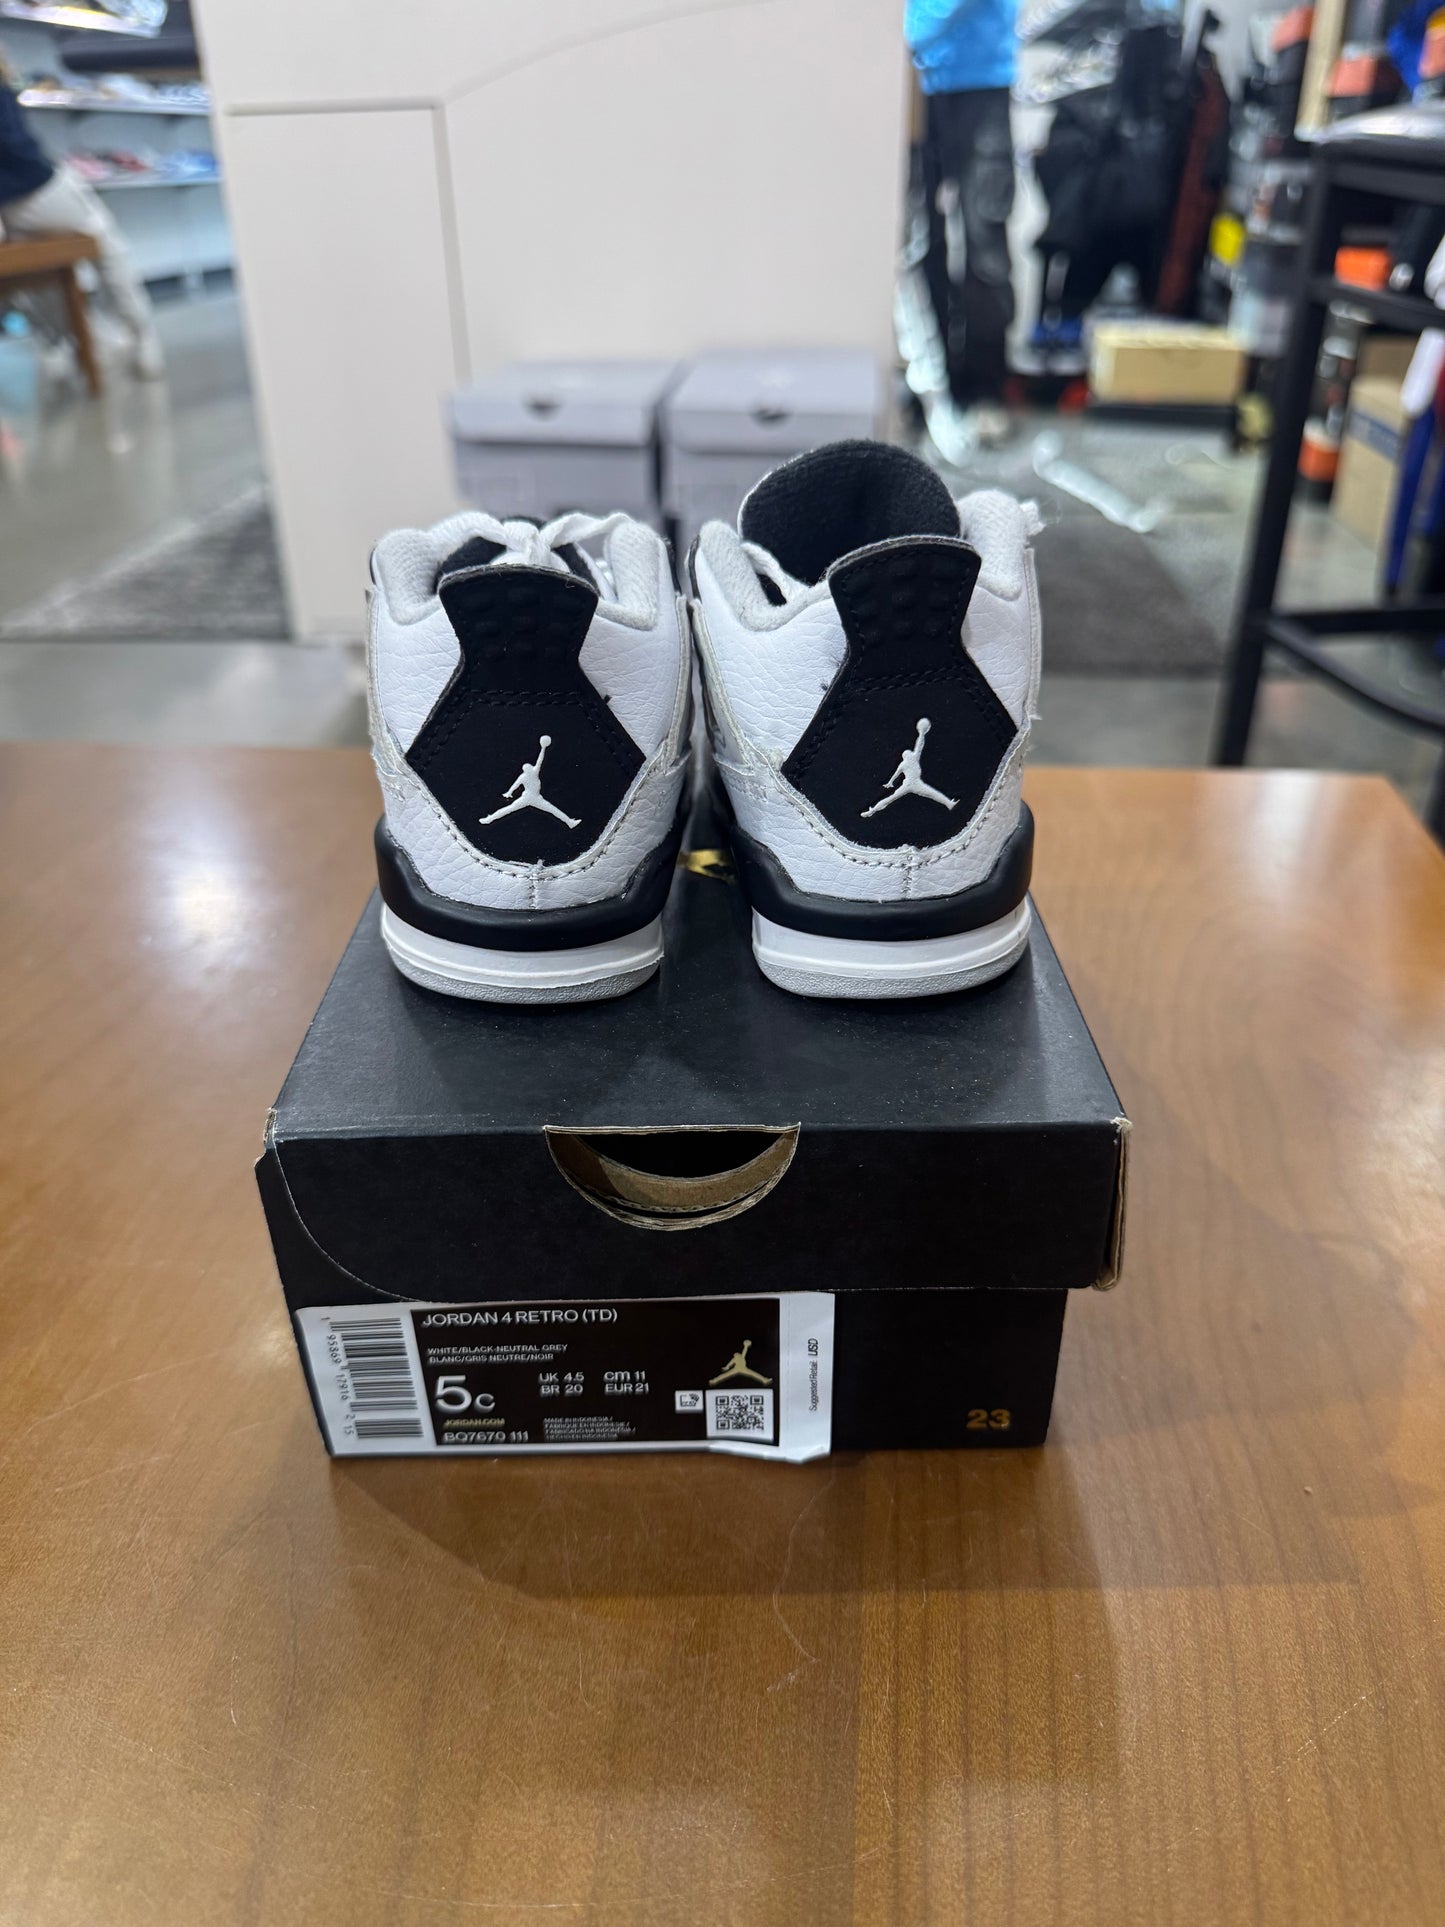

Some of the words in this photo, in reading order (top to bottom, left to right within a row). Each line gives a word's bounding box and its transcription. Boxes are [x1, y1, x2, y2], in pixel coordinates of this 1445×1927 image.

[422, 1312, 499, 1327] JORDAN
[502, 1312, 513, 1323] 4
[516, 1310, 579, 1323] RETRO
[582, 1308, 618, 1323] (TD)
[427, 1344, 539, 1355] WHITE/BLACK-NEUTRAL
[541, 1343, 568, 1352] GREY
[808, 1338, 819, 1357] USD
[429, 1355, 488, 1364] BLANC/GRIS
[489, 1353, 554, 1362] NEUTRE/NOIR
[539, 1372, 559, 1382] UK
[564, 1371, 584, 1382] 4.5
[635, 1370, 646, 1380] 11
[540, 1384, 560, 1395] BR
[564, 1384, 583, 1394] 20
[605, 1383, 633, 1393] EUR
[635, 1382, 649, 1393] 21
[444, 1418, 505, 1426] JORDAN.COM
[966, 1409, 1010, 1429] 23
[510, 1431, 529, 1441] 111
